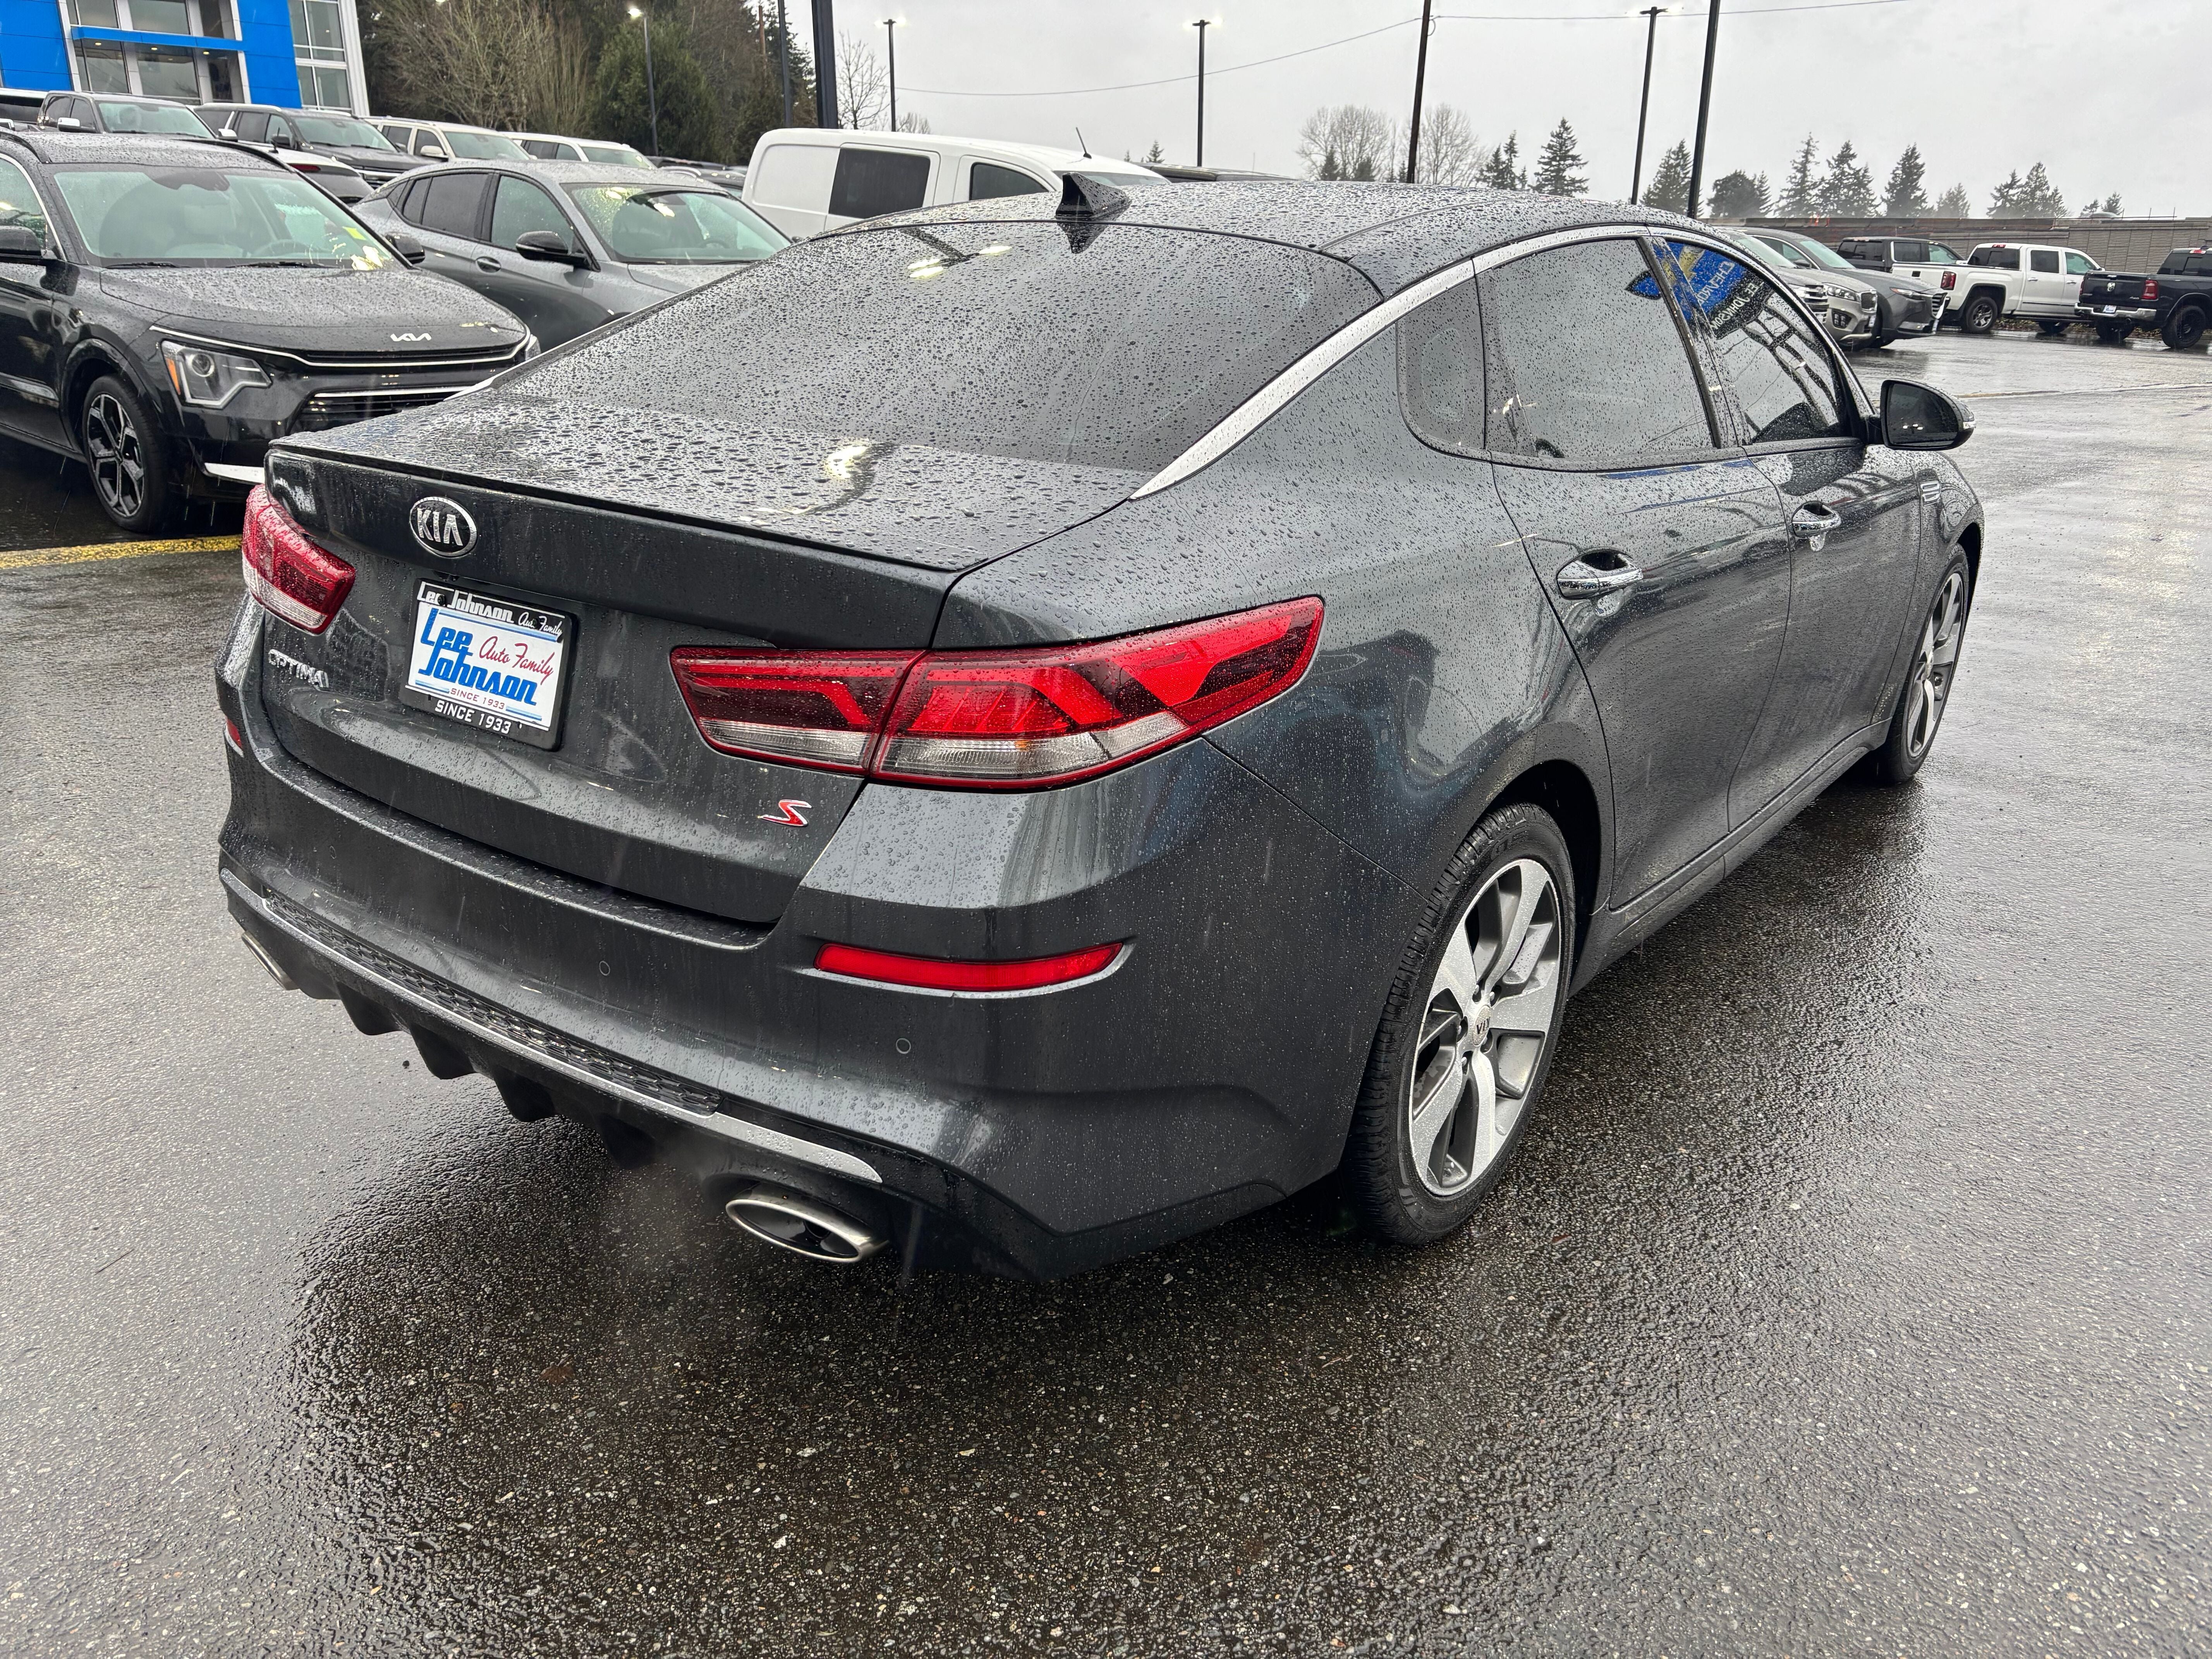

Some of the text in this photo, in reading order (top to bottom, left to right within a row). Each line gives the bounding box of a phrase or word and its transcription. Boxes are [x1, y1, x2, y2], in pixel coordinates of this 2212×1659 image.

[417, 508, 463, 546] KIA
[421, 608, 473, 653] Lee
[447, 590, 514, 623] Johnson
[518, 611, 537, 628] Aut
[539, 616, 562, 641] Family
[268, 649, 329, 688] OPTIMA
[418, 646, 538, 706] Johnson
[479, 636, 555, 685] Auto Family
[435, 700, 512, 734] SINCE 1933
[450, 688, 505, 709] SINCE 1933
[757, 799, 812, 827] S
